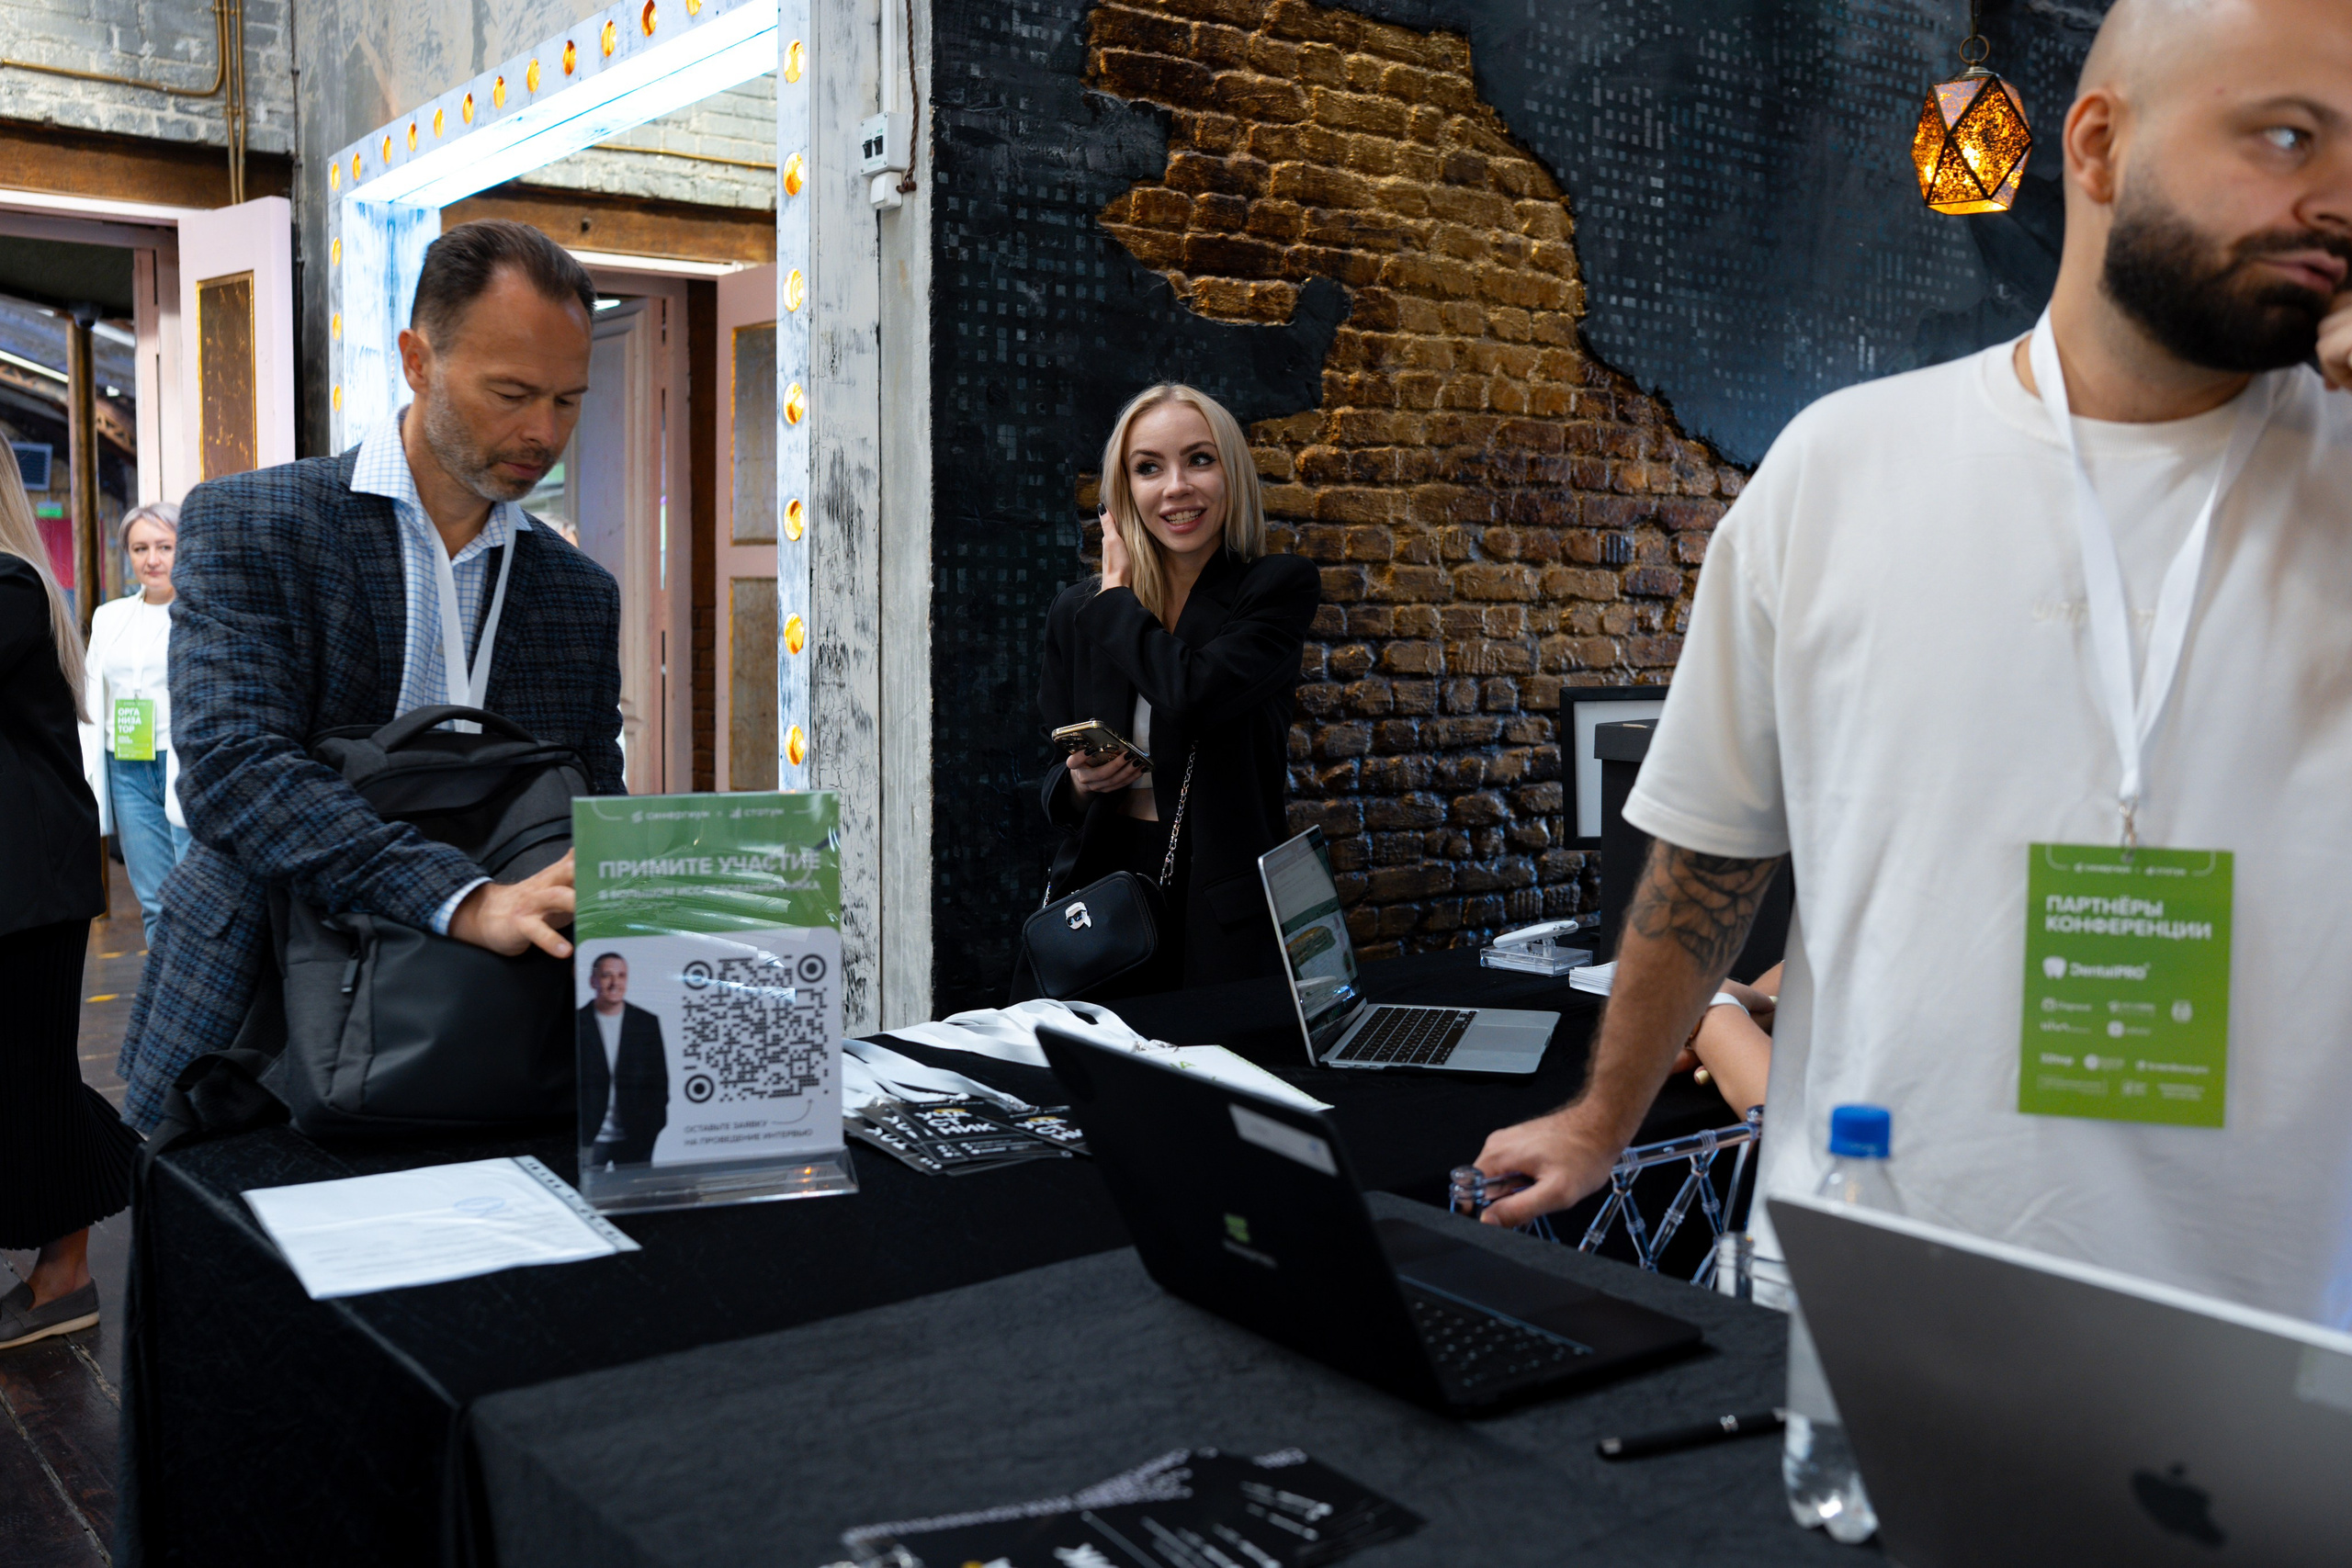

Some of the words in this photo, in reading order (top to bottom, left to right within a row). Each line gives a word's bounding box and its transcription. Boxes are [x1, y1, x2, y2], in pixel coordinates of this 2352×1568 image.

[118, 707, 140, 716] ОРГА
[118, 716, 141, 725] НИЗА
[119, 725, 135, 734] ТОР
[598, 855, 713, 879] ПРИМИТЕ
[717, 851, 821, 874] УЧАСТИЕ
[2045, 894, 2164, 918] ПАРТНЁРЫ
[2044, 915, 2213, 940] КОНФЕРЕНЦИИ
[684, 1122, 729, 1134] ОСТАВЬТЕ
[700, 1134, 761, 1145] ПРОВЕДЕНИЕ
[763, 1128, 814, 1139] ИНТЕРВЬЮ
